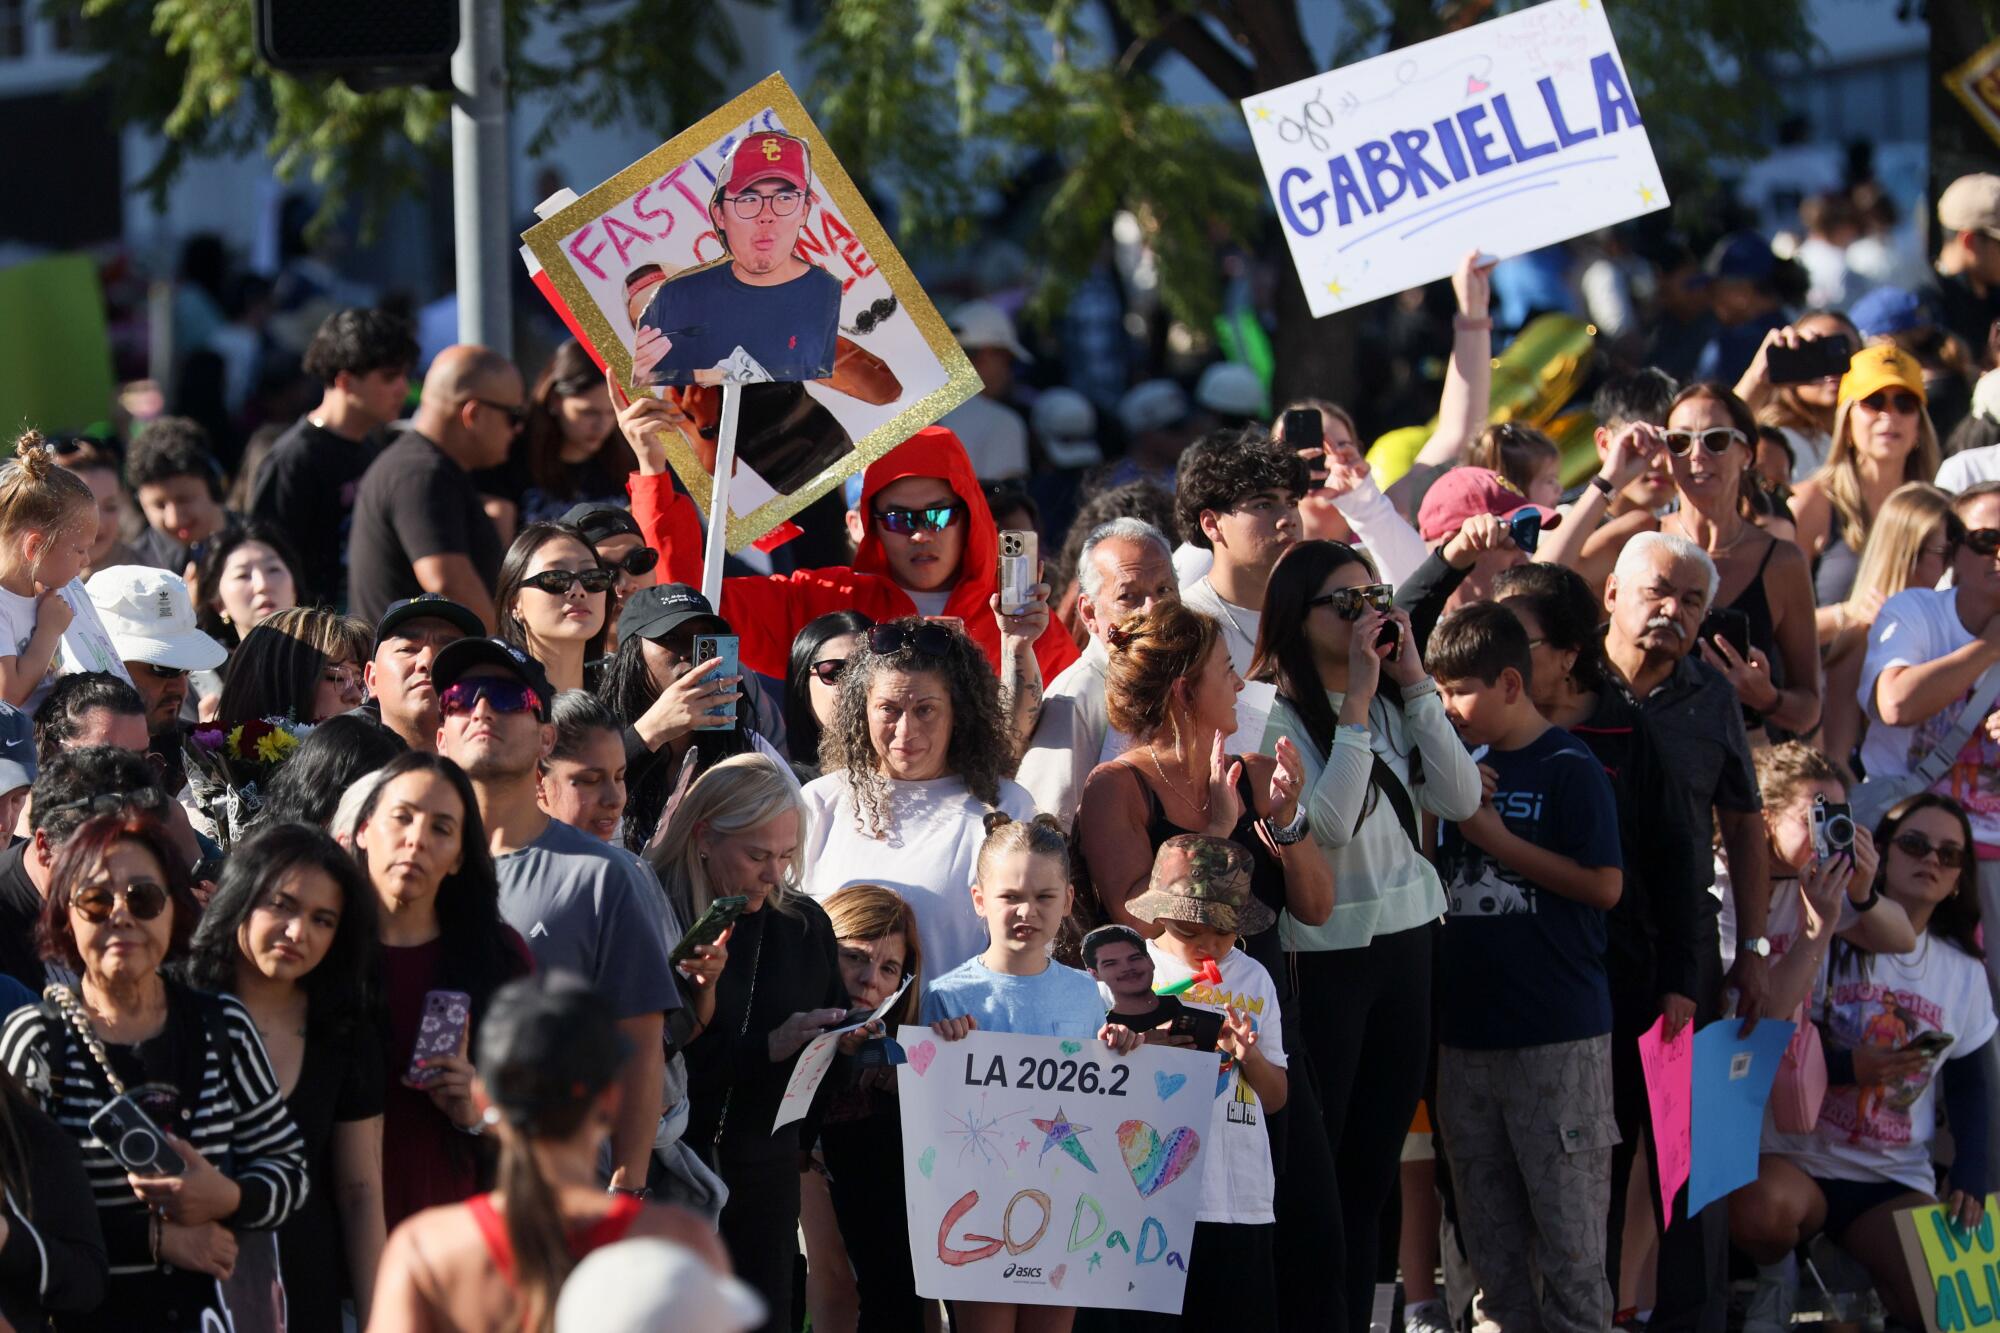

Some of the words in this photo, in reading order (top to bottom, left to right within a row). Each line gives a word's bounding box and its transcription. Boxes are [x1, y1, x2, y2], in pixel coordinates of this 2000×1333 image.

[1278, 87, 1334, 153] go
[1279, 51, 1644, 237] GABRIELLA
[965, 1053, 1008, 1088] LA
[1016, 1056, 1130, 1097] 2026.2
[937, 1188, 1051, 1267] GO
